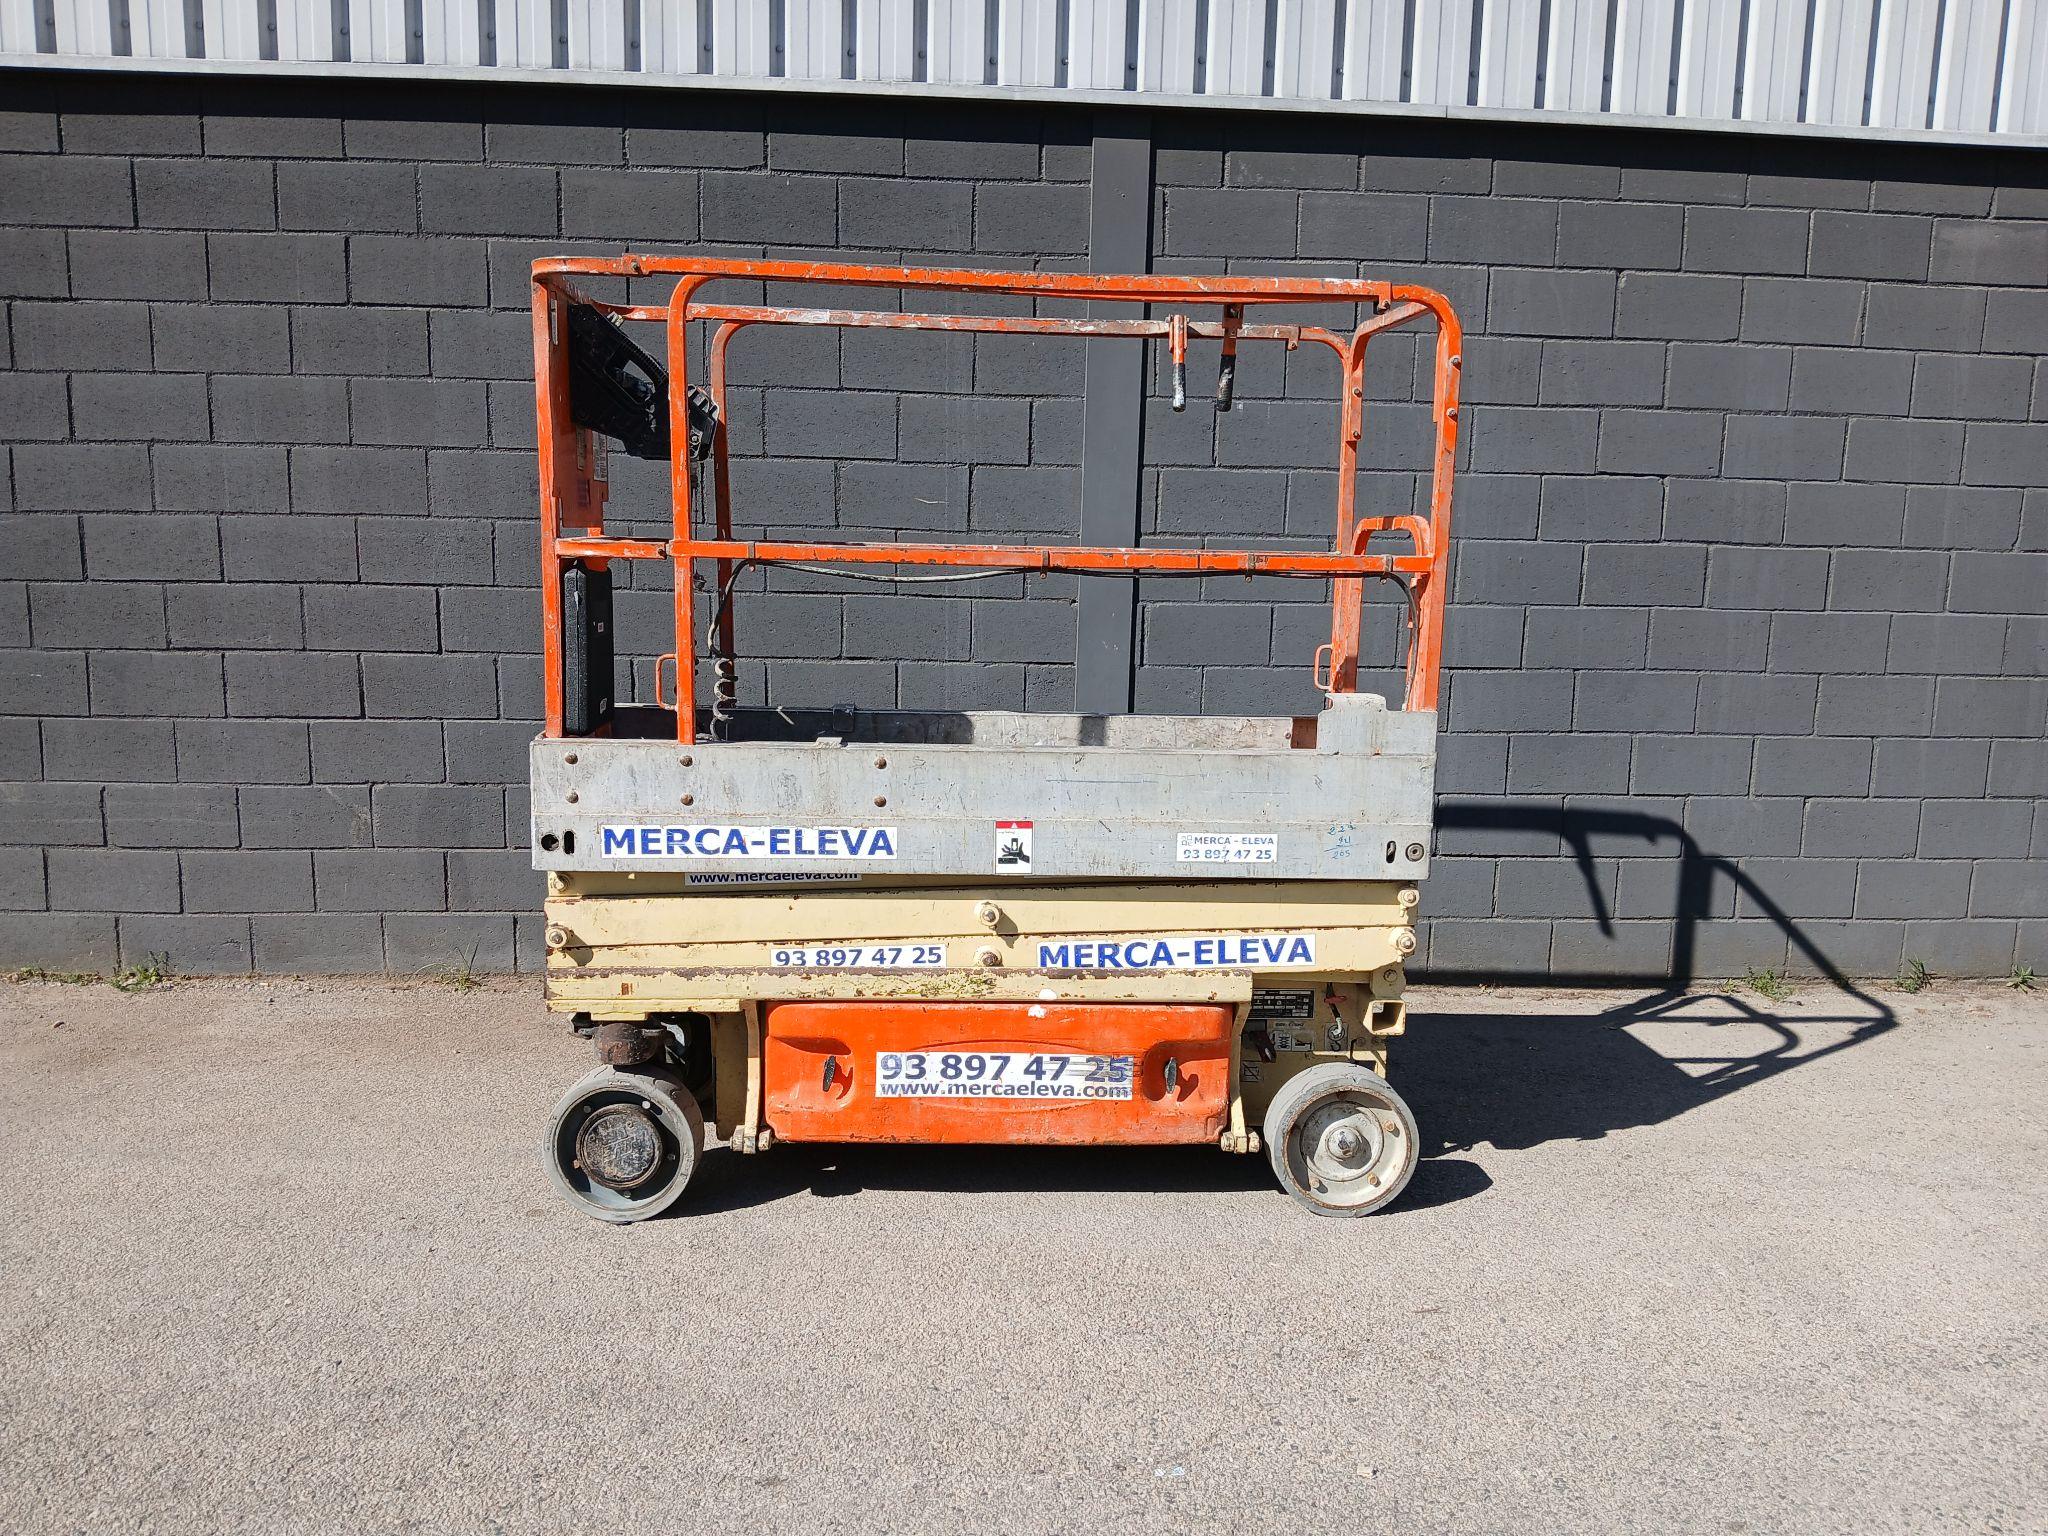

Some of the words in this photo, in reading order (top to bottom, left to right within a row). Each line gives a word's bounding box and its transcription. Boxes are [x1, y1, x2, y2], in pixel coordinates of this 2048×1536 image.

[602, 828, 895, 856] MERCA-ELEVA
[1194, 836, 1231, 845] MERCA
[1241, 837, 1274, 845] ELEVA
[1183, 849, 1200, 859] 93
[1204, 849, 1230, 859] 897
[1234, 850, 1251, 859] 47
[1255, 850, 1272, 860] 25
[775, 950, 807, 967] 93
[815, 949, 863, 967] 897
[871, 948, 902, 965] 47
[912, 946, 942, 964] 25
[1039, 937, 1313, 968] MERCA-ELEVA
[880, 1054, 927, 1080] 93
[939, 1054, 1011, 1081] 897
[1023, 1055, 1070, 1081] 47
[1084, 1056, 1129, 1083] 25
[880, 1080, 1131, 1099] www.mercaeleva.com
